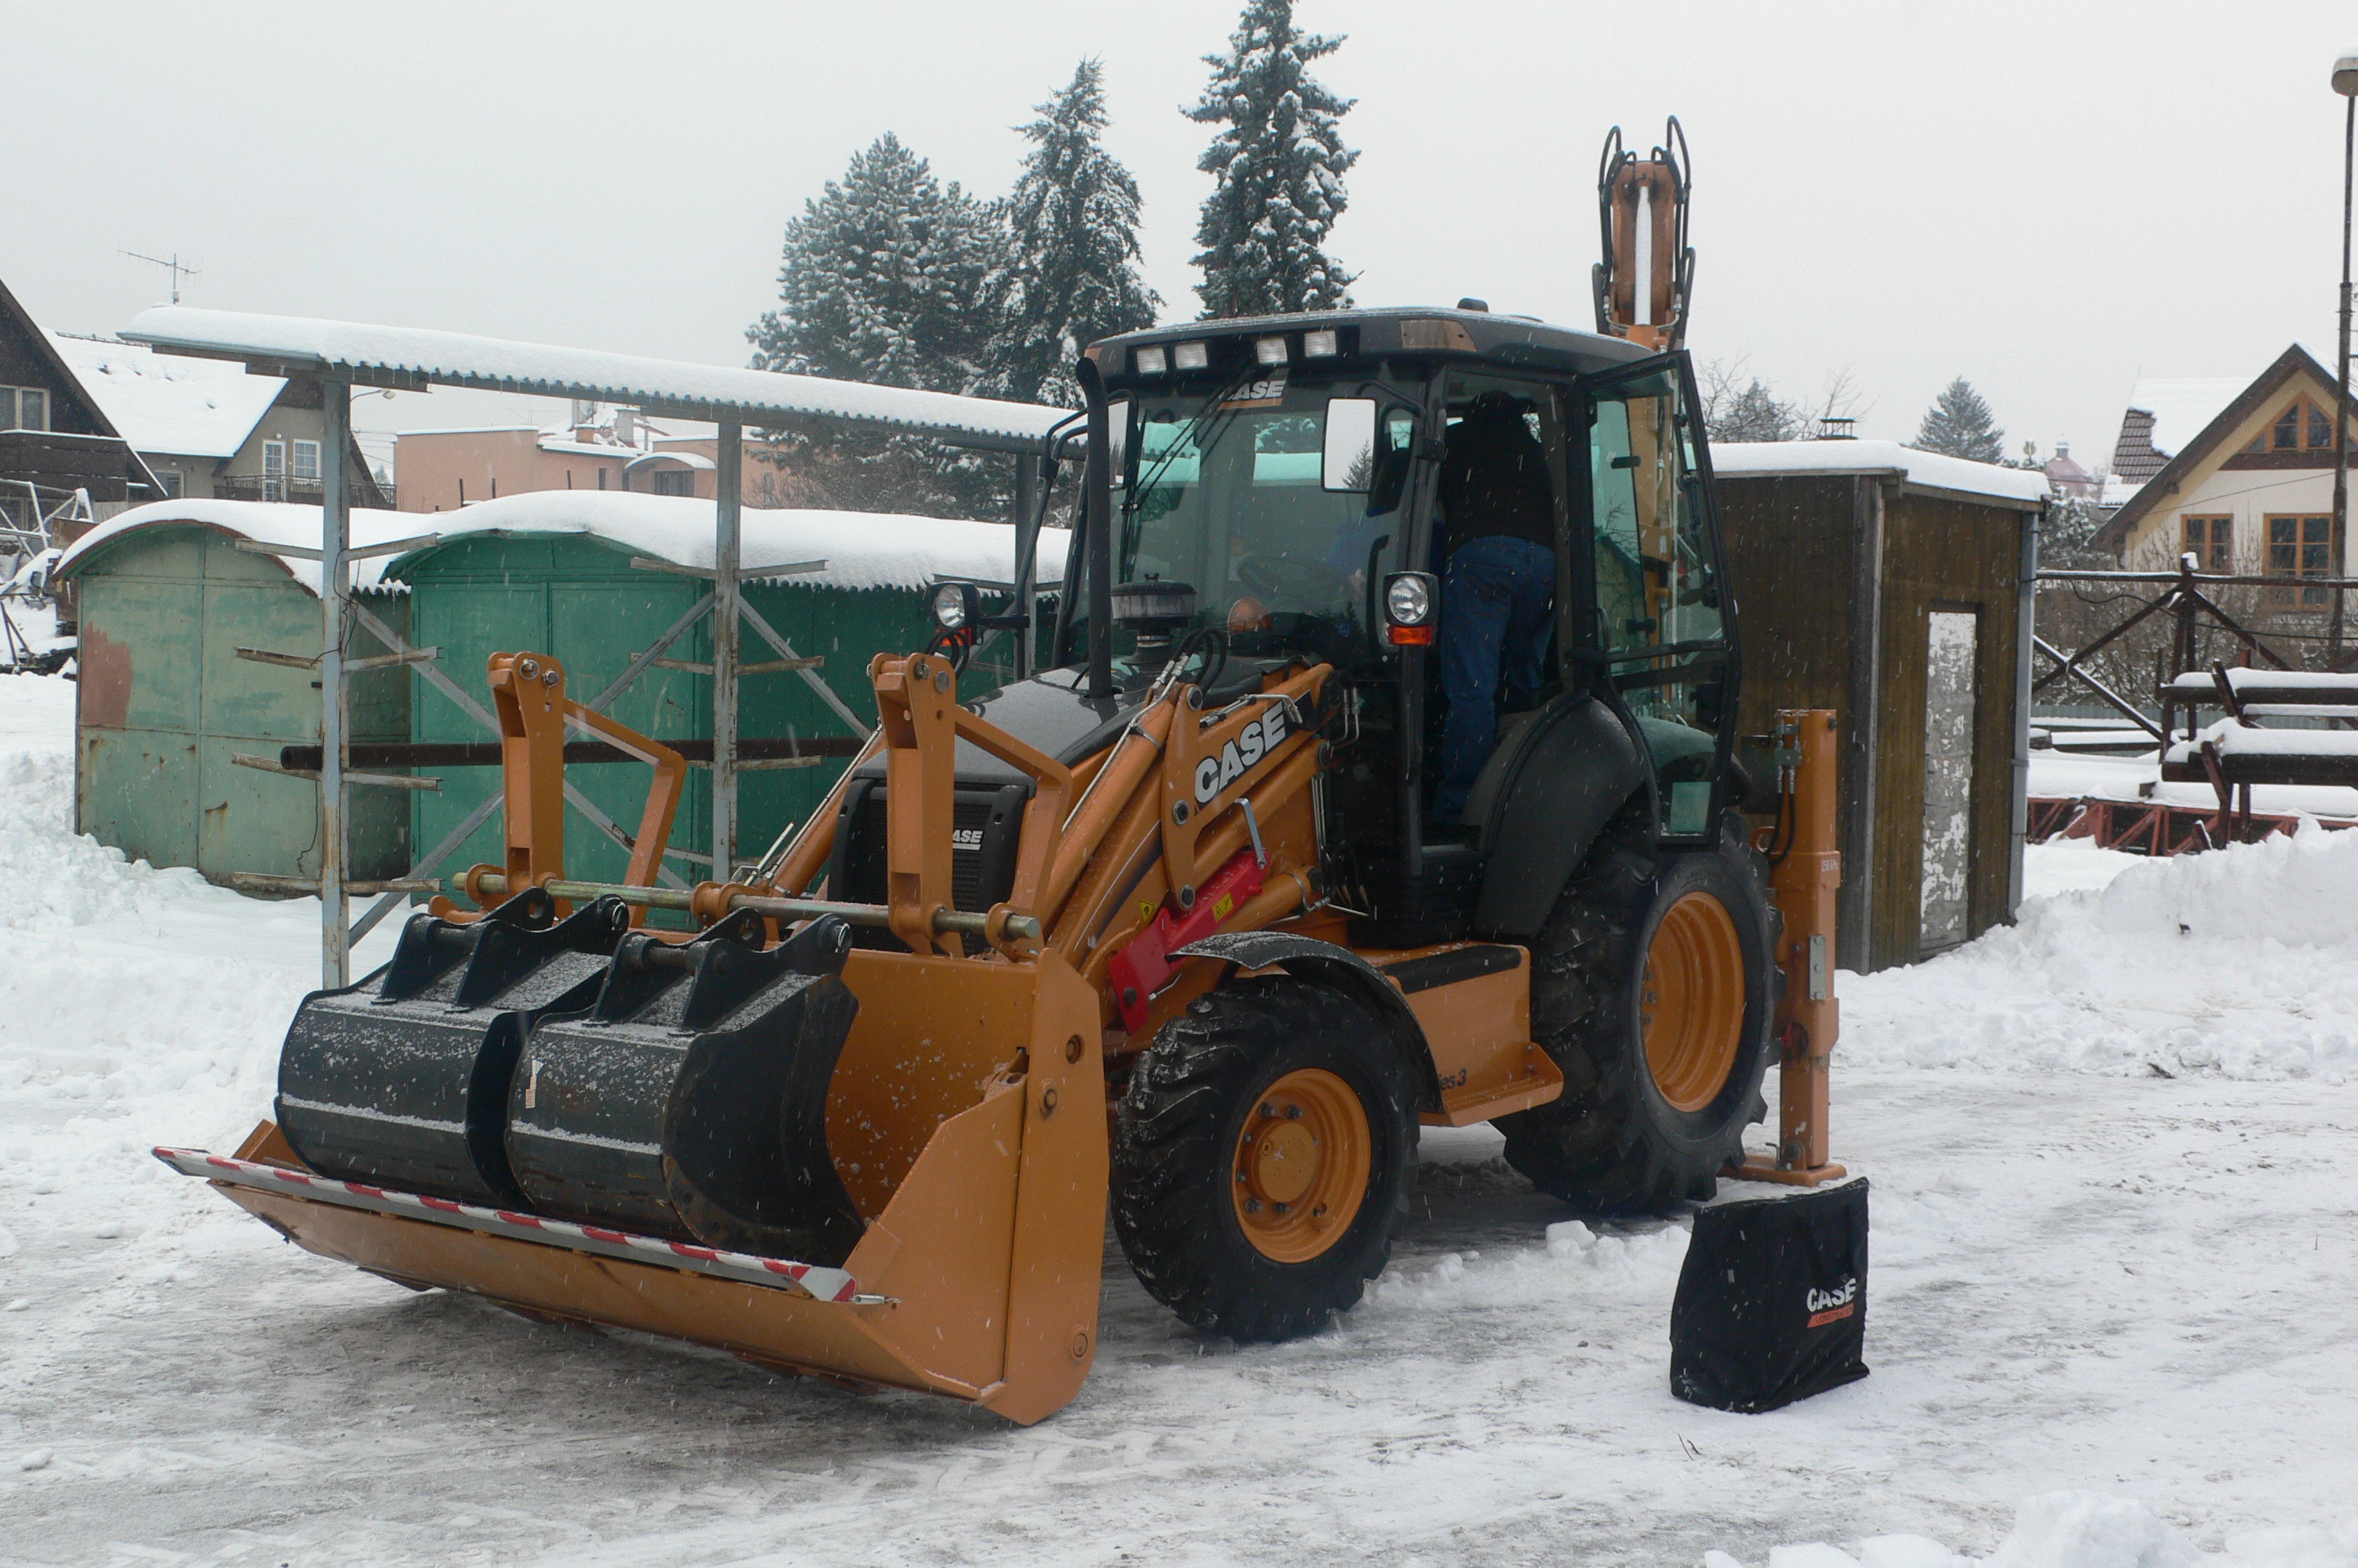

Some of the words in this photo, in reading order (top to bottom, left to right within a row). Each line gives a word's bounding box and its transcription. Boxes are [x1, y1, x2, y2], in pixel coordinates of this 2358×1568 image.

[1219, 378, 1286, 401] ASE
[1195, 701, 1286, 803] CASE
[952, 829, 984, 844] ASE
[1457, 1068, 1467, 1087] 3
[1806, 1278, 1856, 1312] CASE
